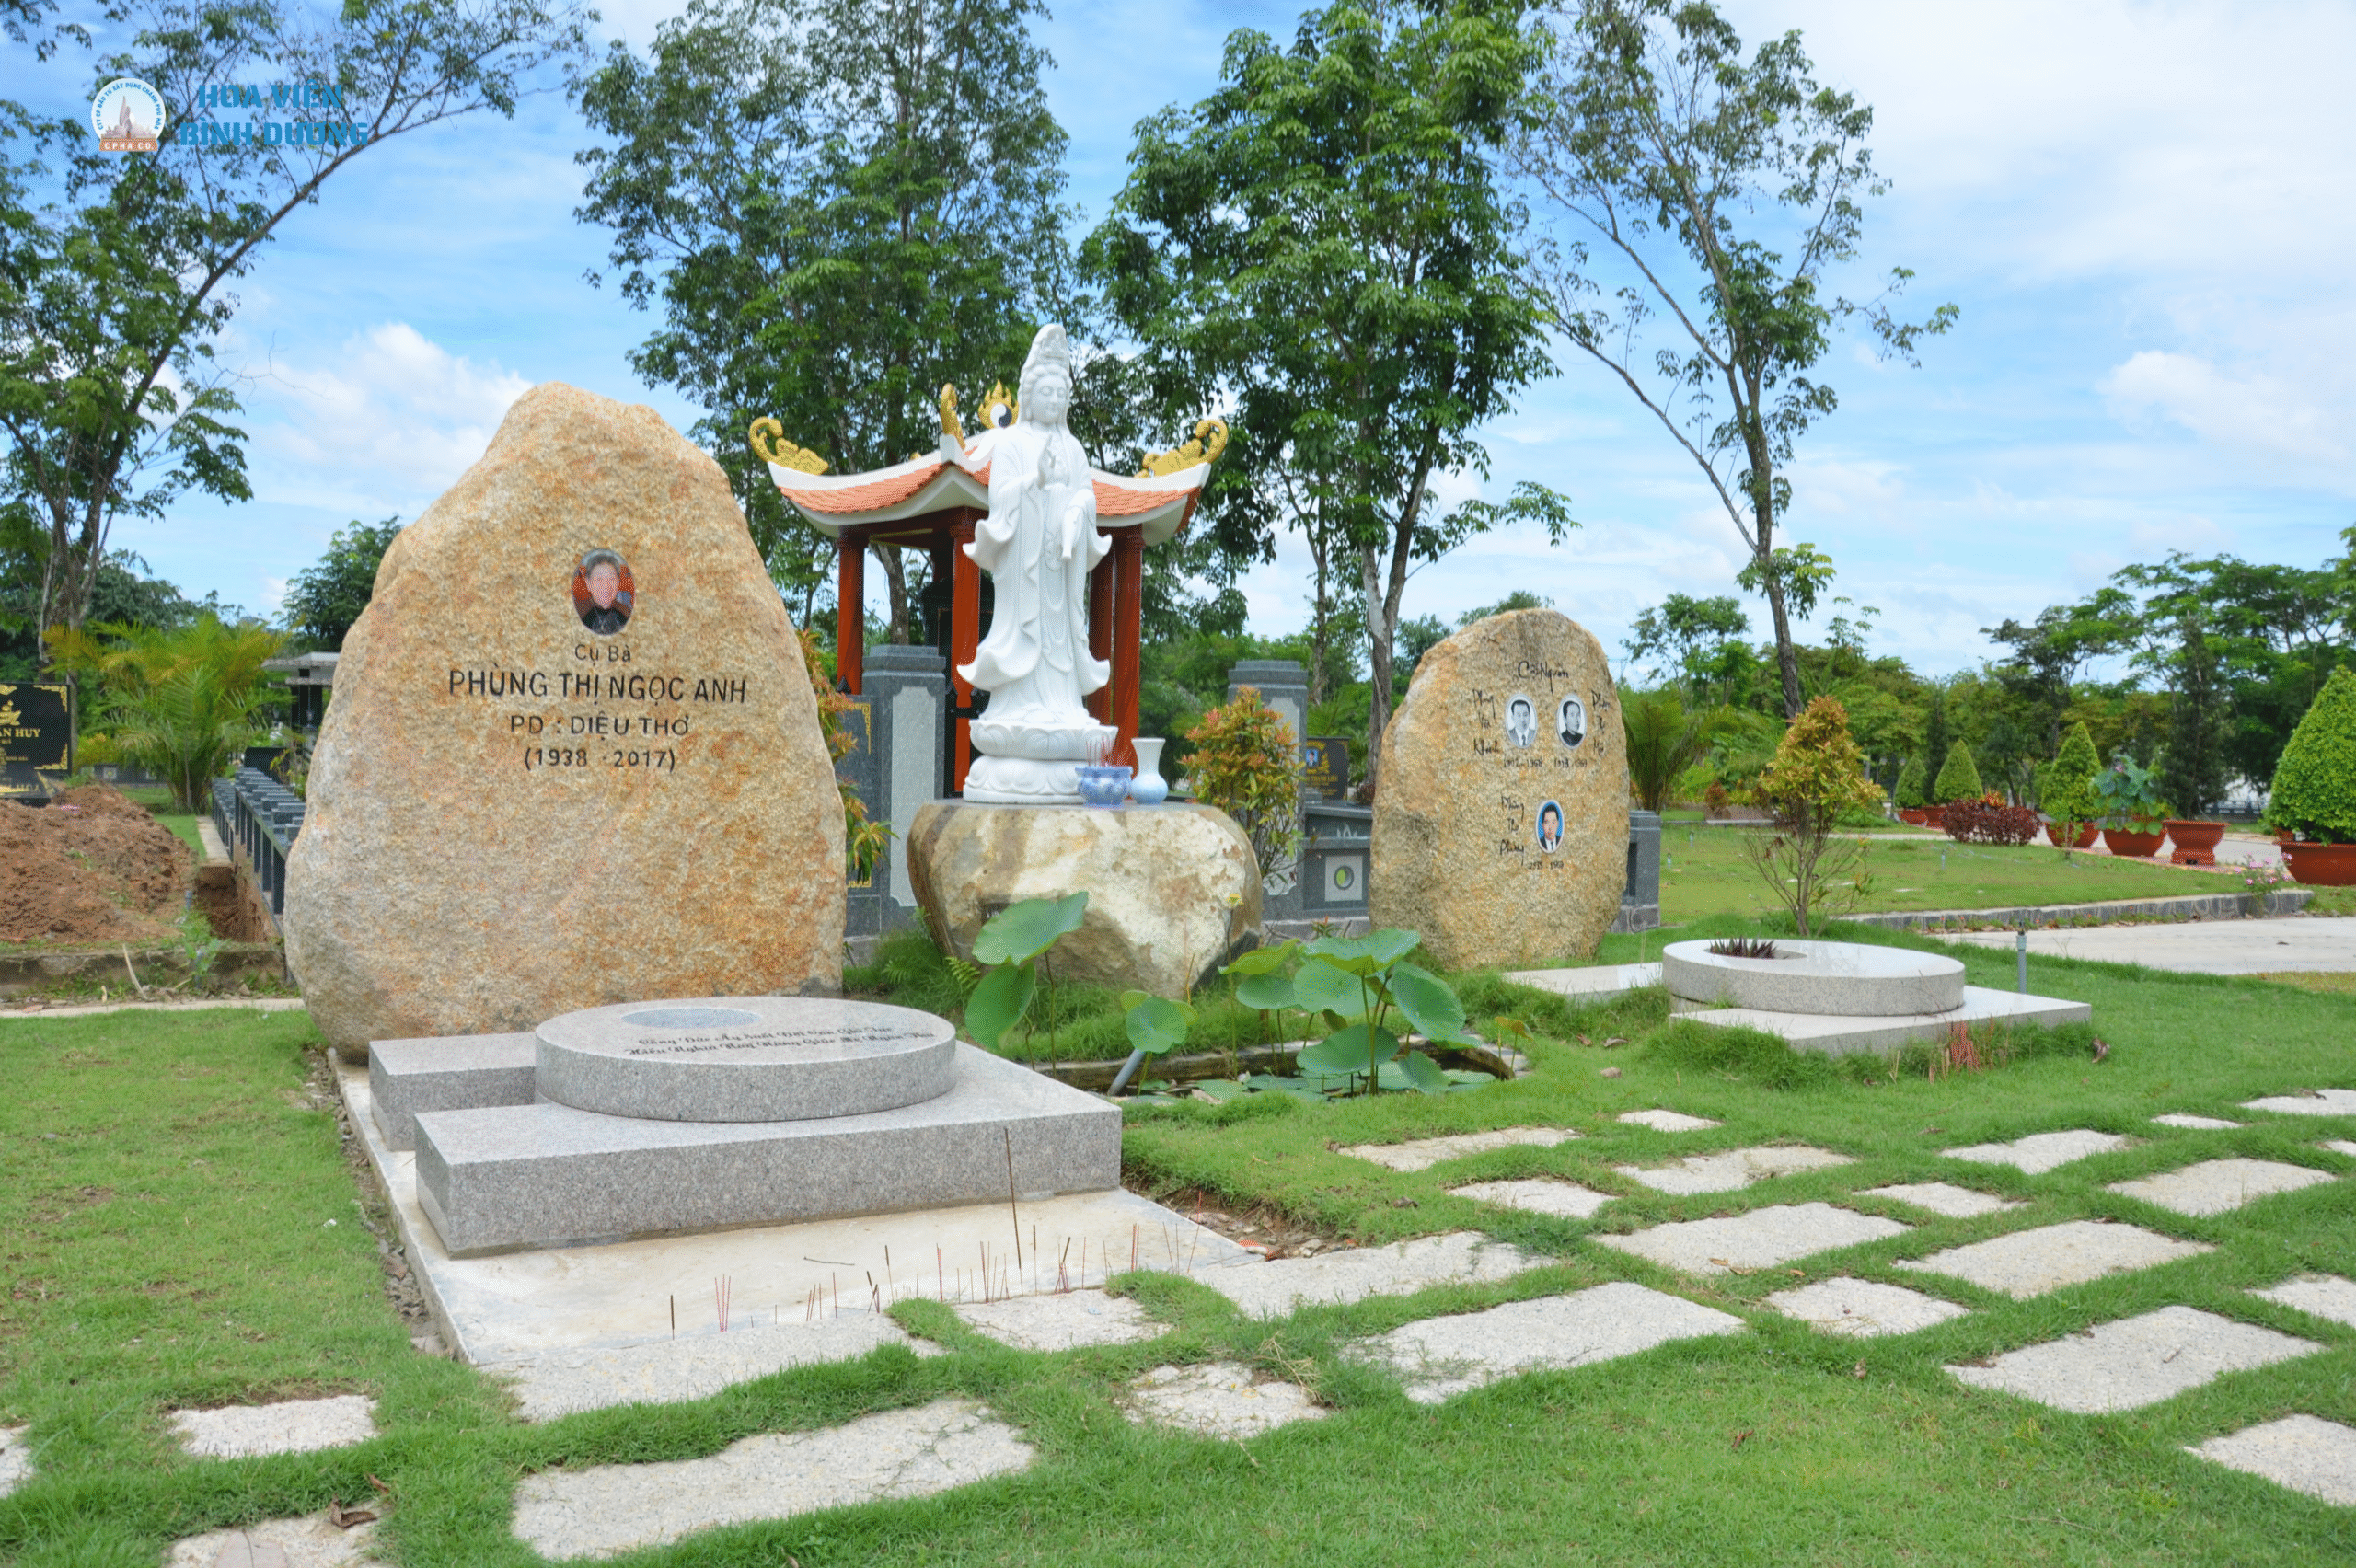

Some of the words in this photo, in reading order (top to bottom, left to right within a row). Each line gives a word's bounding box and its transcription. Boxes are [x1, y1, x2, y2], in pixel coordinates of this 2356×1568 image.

[574, 644, 599, 666] Cụ
[608, 644, 632, 663] Bà
[449, 663, 548, 697] PHÙNG
[558, 673, 598, 706] THỊ
[609, 675, 684, 706] NGỌC
[693, 679, 746, 703] ANH
[15, 728, 40, 738] HUY
[511, 716, 544, 733] PD
[571, 711, 629, 741] DIỆU
[638, 715, 689, 735] THƠ
[525, 748, 588, 771] (1938
[614, 749, 676, 773] 2017)
